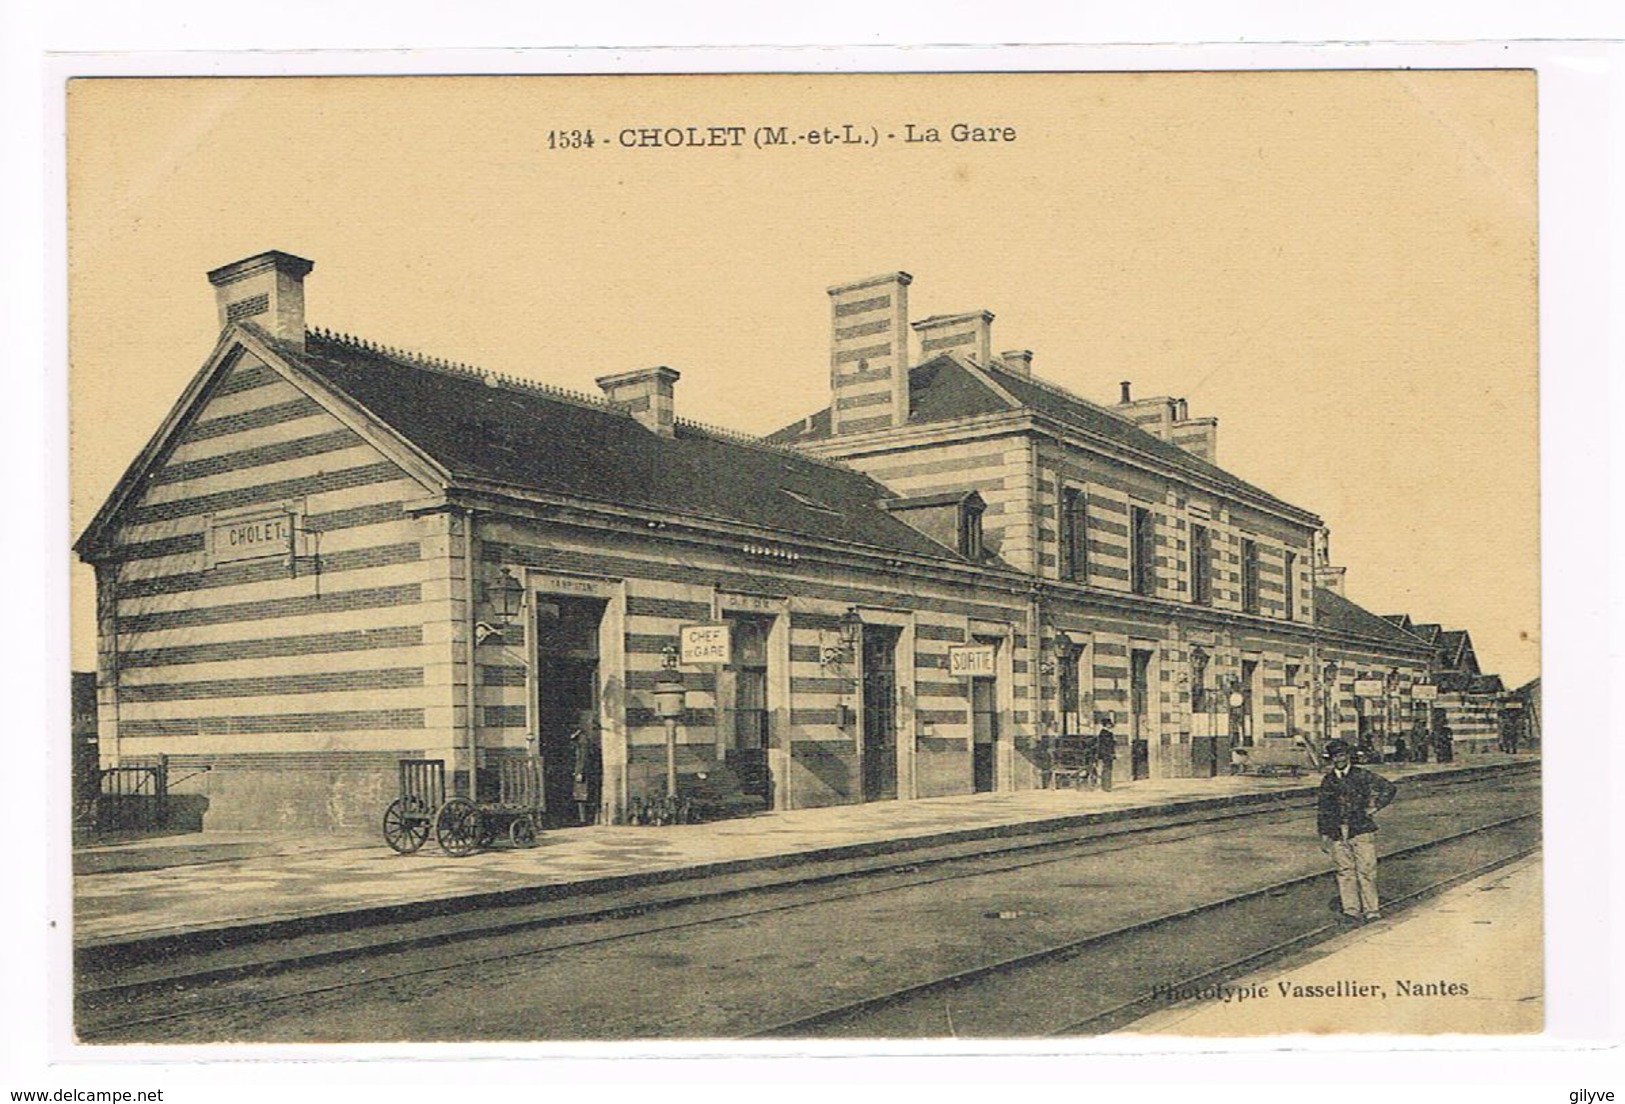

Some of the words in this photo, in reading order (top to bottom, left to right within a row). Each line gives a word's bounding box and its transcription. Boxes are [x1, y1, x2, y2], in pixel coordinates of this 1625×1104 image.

[229, 521, 281, 546] CHOLET
[689, 630, 720, 643] CHEF
[694, 645, 725, 657] GARE
[953, 651, 991, 670] SORTIE
